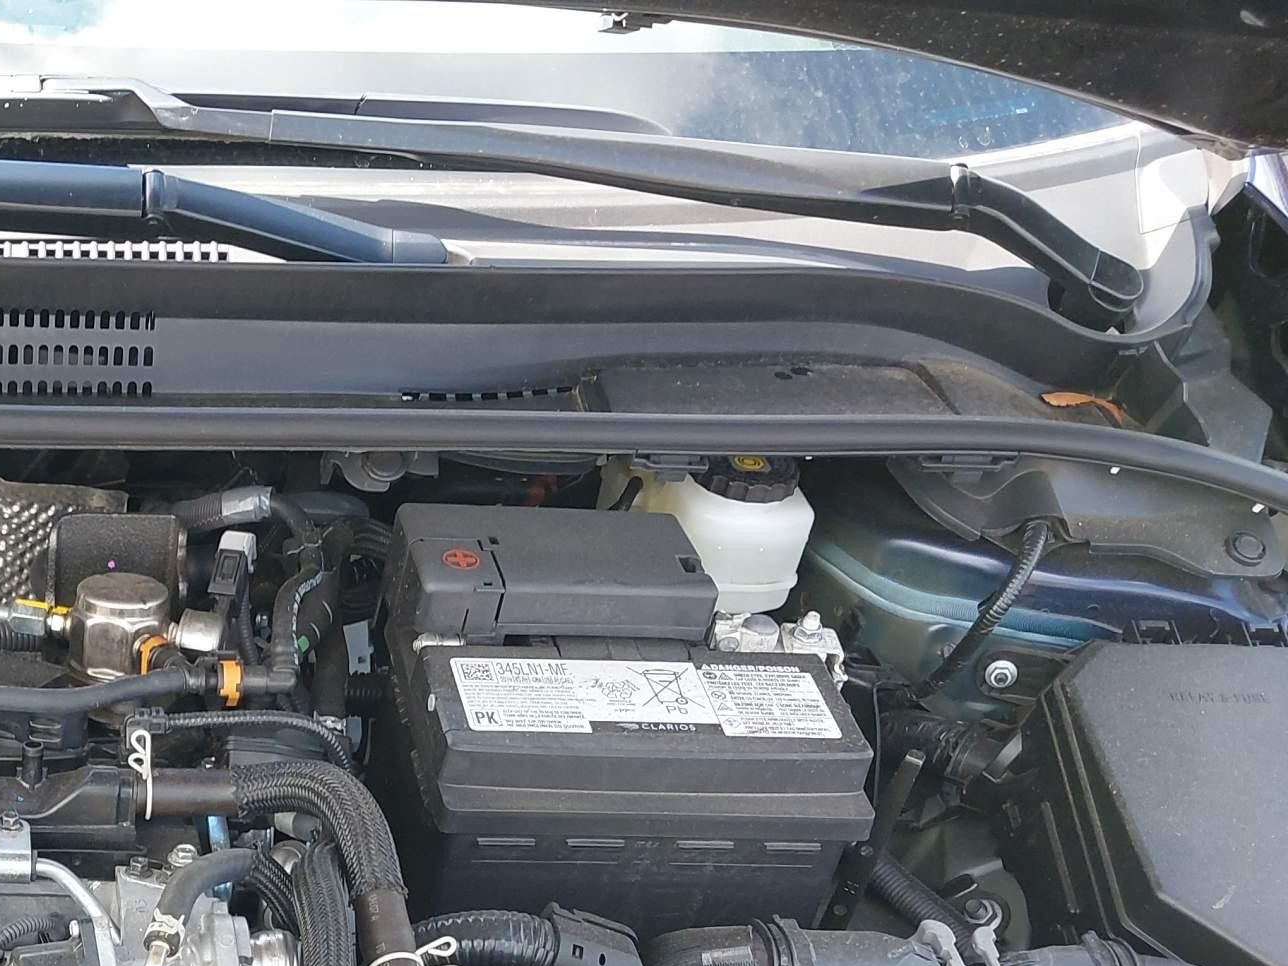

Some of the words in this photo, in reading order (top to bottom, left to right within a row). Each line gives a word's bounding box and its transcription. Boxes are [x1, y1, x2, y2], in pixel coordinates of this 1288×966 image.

[496, 662, 568, 676] 345LN1-MF
[711, 664, 800, 673] DANGER/POISON
[666, 705, 689, 715] Pb
[475, 711, 499, 725] PK
[641, 723, 696, 732] CLARIOS
